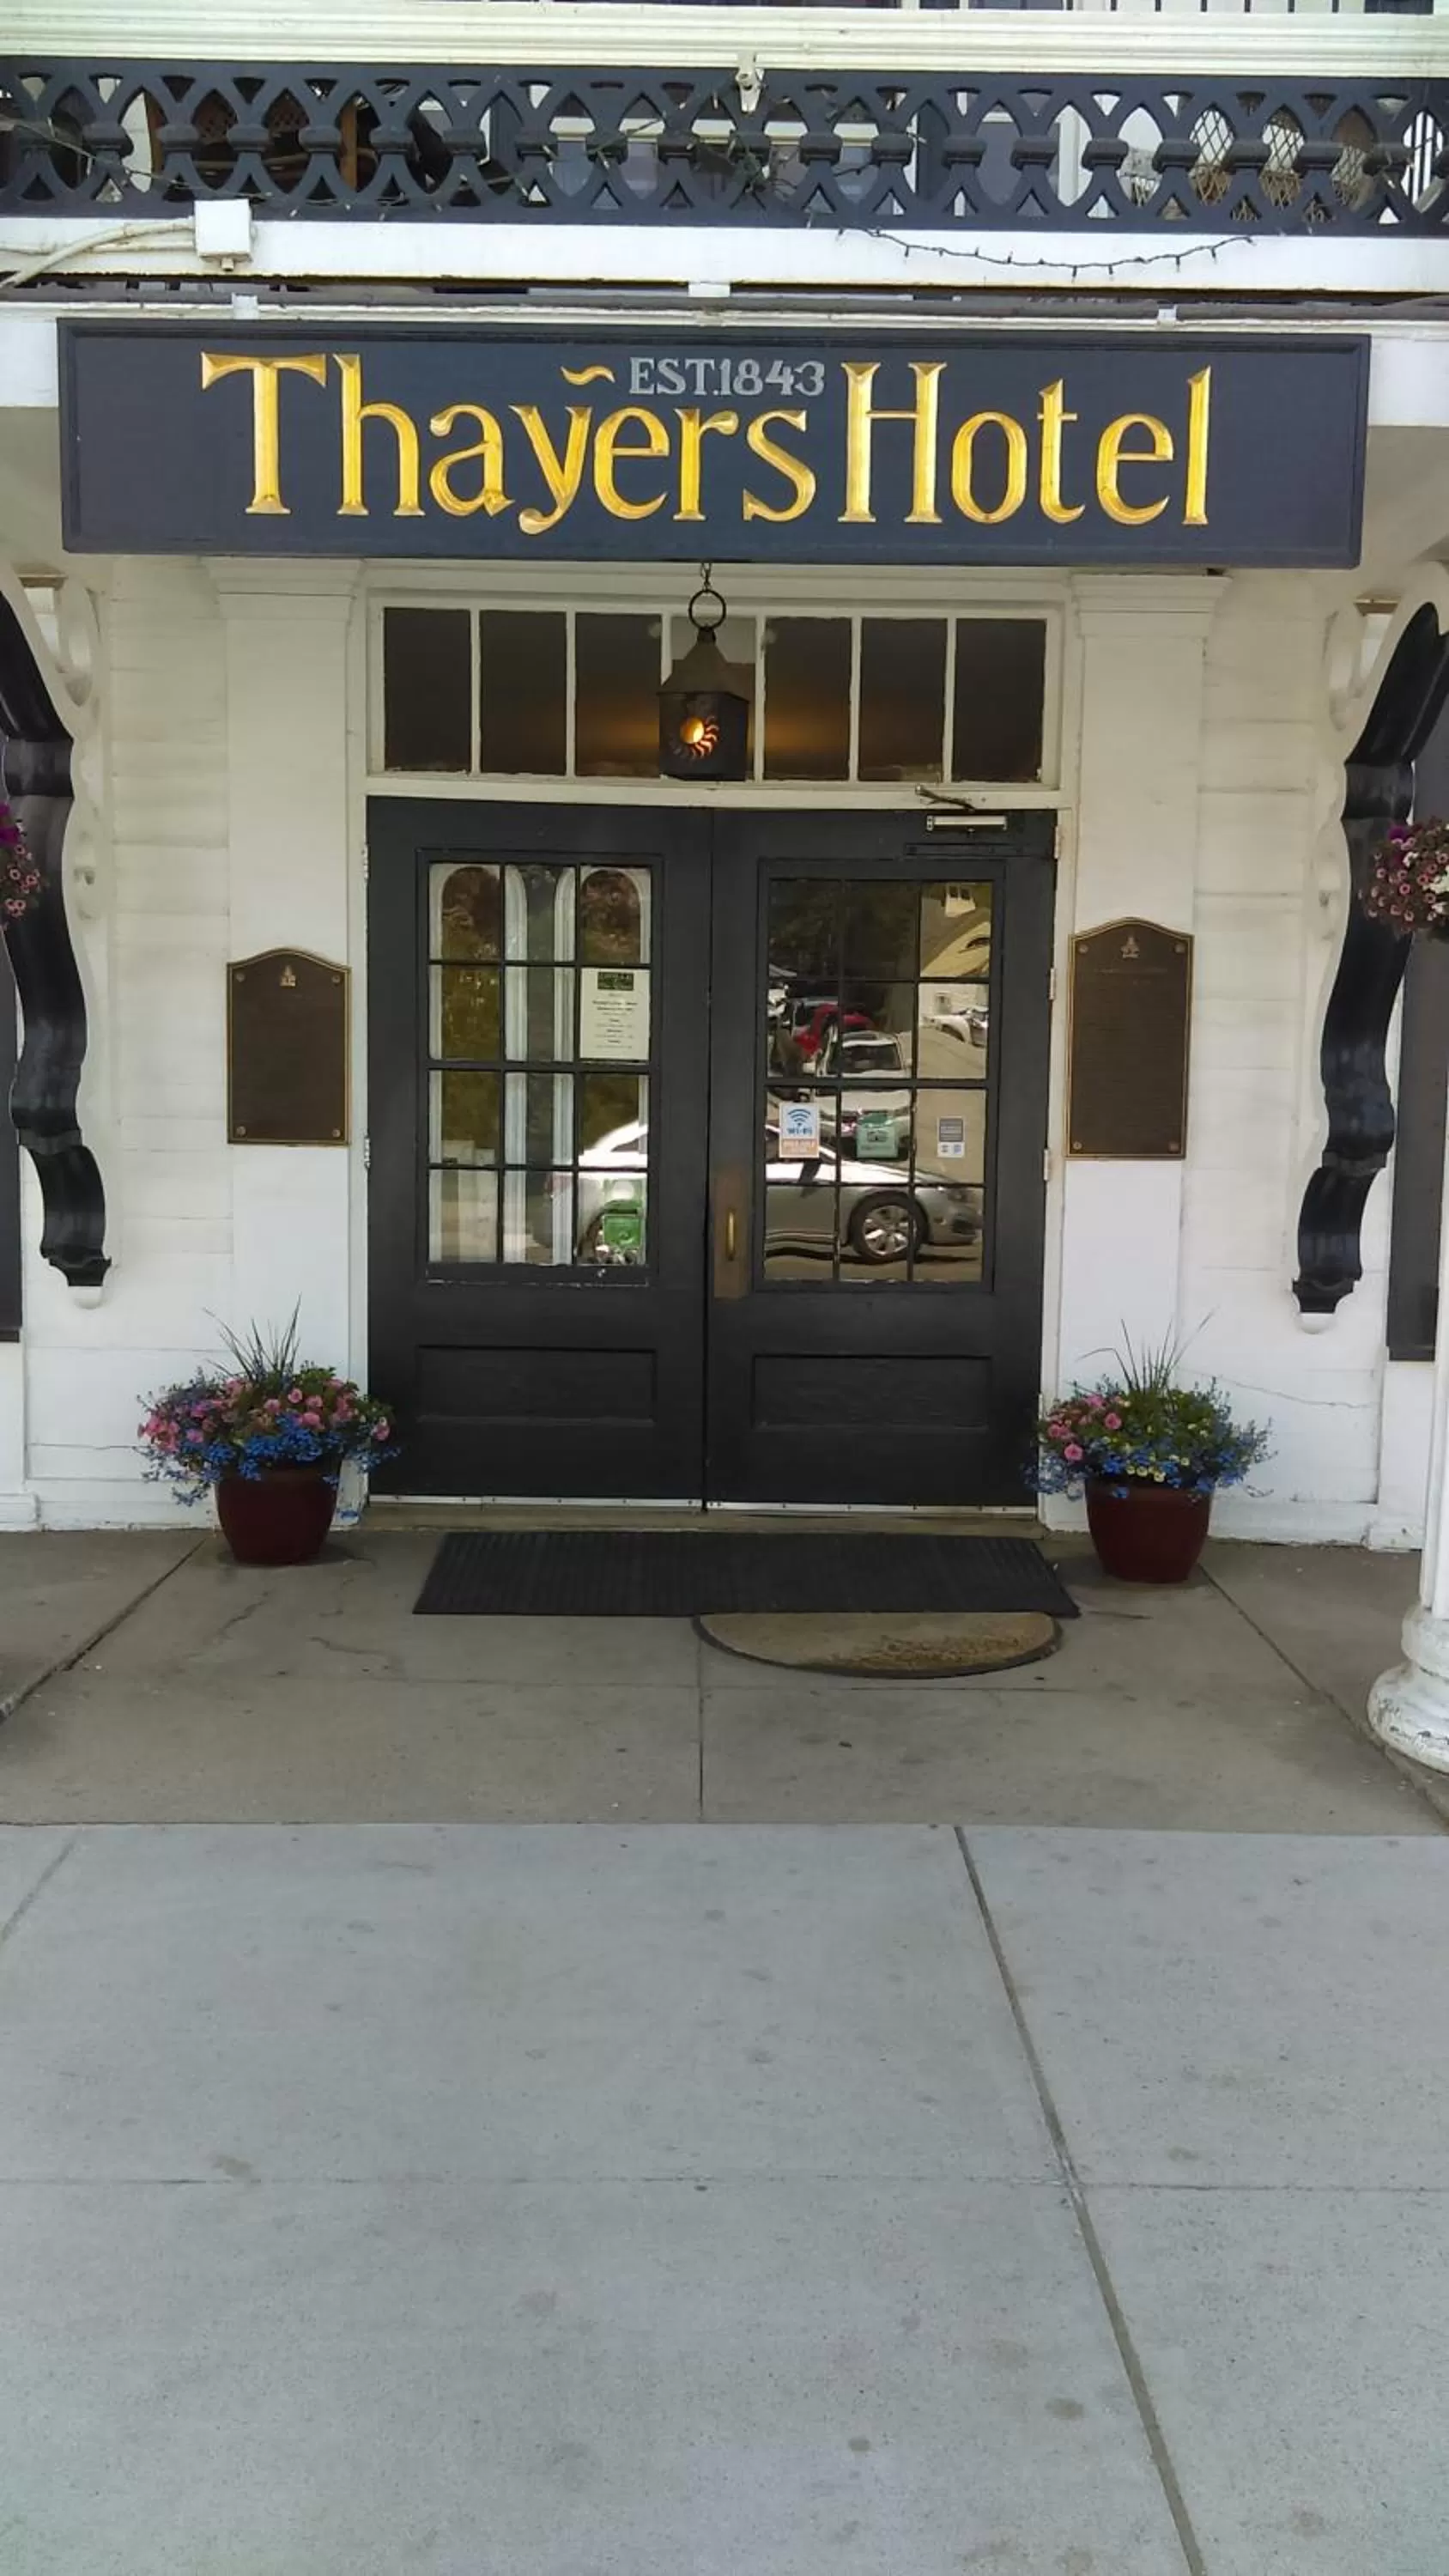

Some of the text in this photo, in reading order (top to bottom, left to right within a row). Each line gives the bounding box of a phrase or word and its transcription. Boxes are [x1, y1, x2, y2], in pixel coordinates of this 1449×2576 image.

[629, 356, 825, 396] EST.1843
[201, 353, 1210, 533] Thayers Hotel
